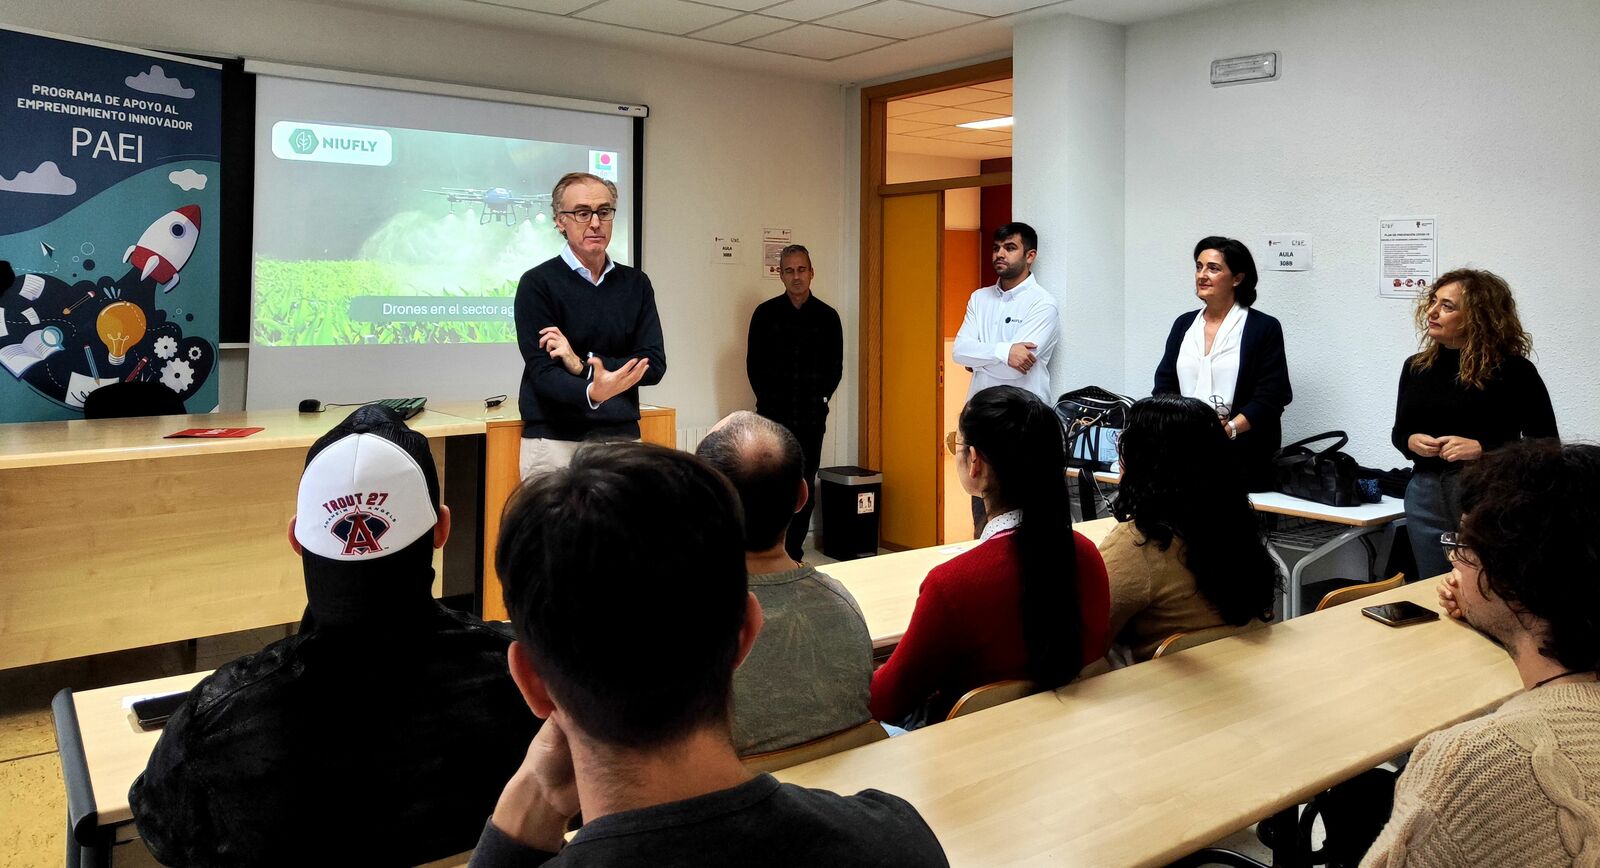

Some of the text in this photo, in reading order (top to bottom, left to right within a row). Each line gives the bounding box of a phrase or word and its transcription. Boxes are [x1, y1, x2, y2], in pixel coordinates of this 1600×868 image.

[32, 84, 179, 115] PROGRAMA DE APOYO AL
[17, 97, 193, 131] EMPRENDIMIENTO INNOVADOR
[71, 127, 143, 164] PAEI
[322, 137, 378, 152] NIUFLY
[382, 303, 428, 315] Drones
[430, 305, 446, 315] en
[448, 303, 459, 315] el
[462, 304, 498, 315] sector
[322, 492, 389, 514] TROUT 27
[368, 506, 397, 523] ANGELS
